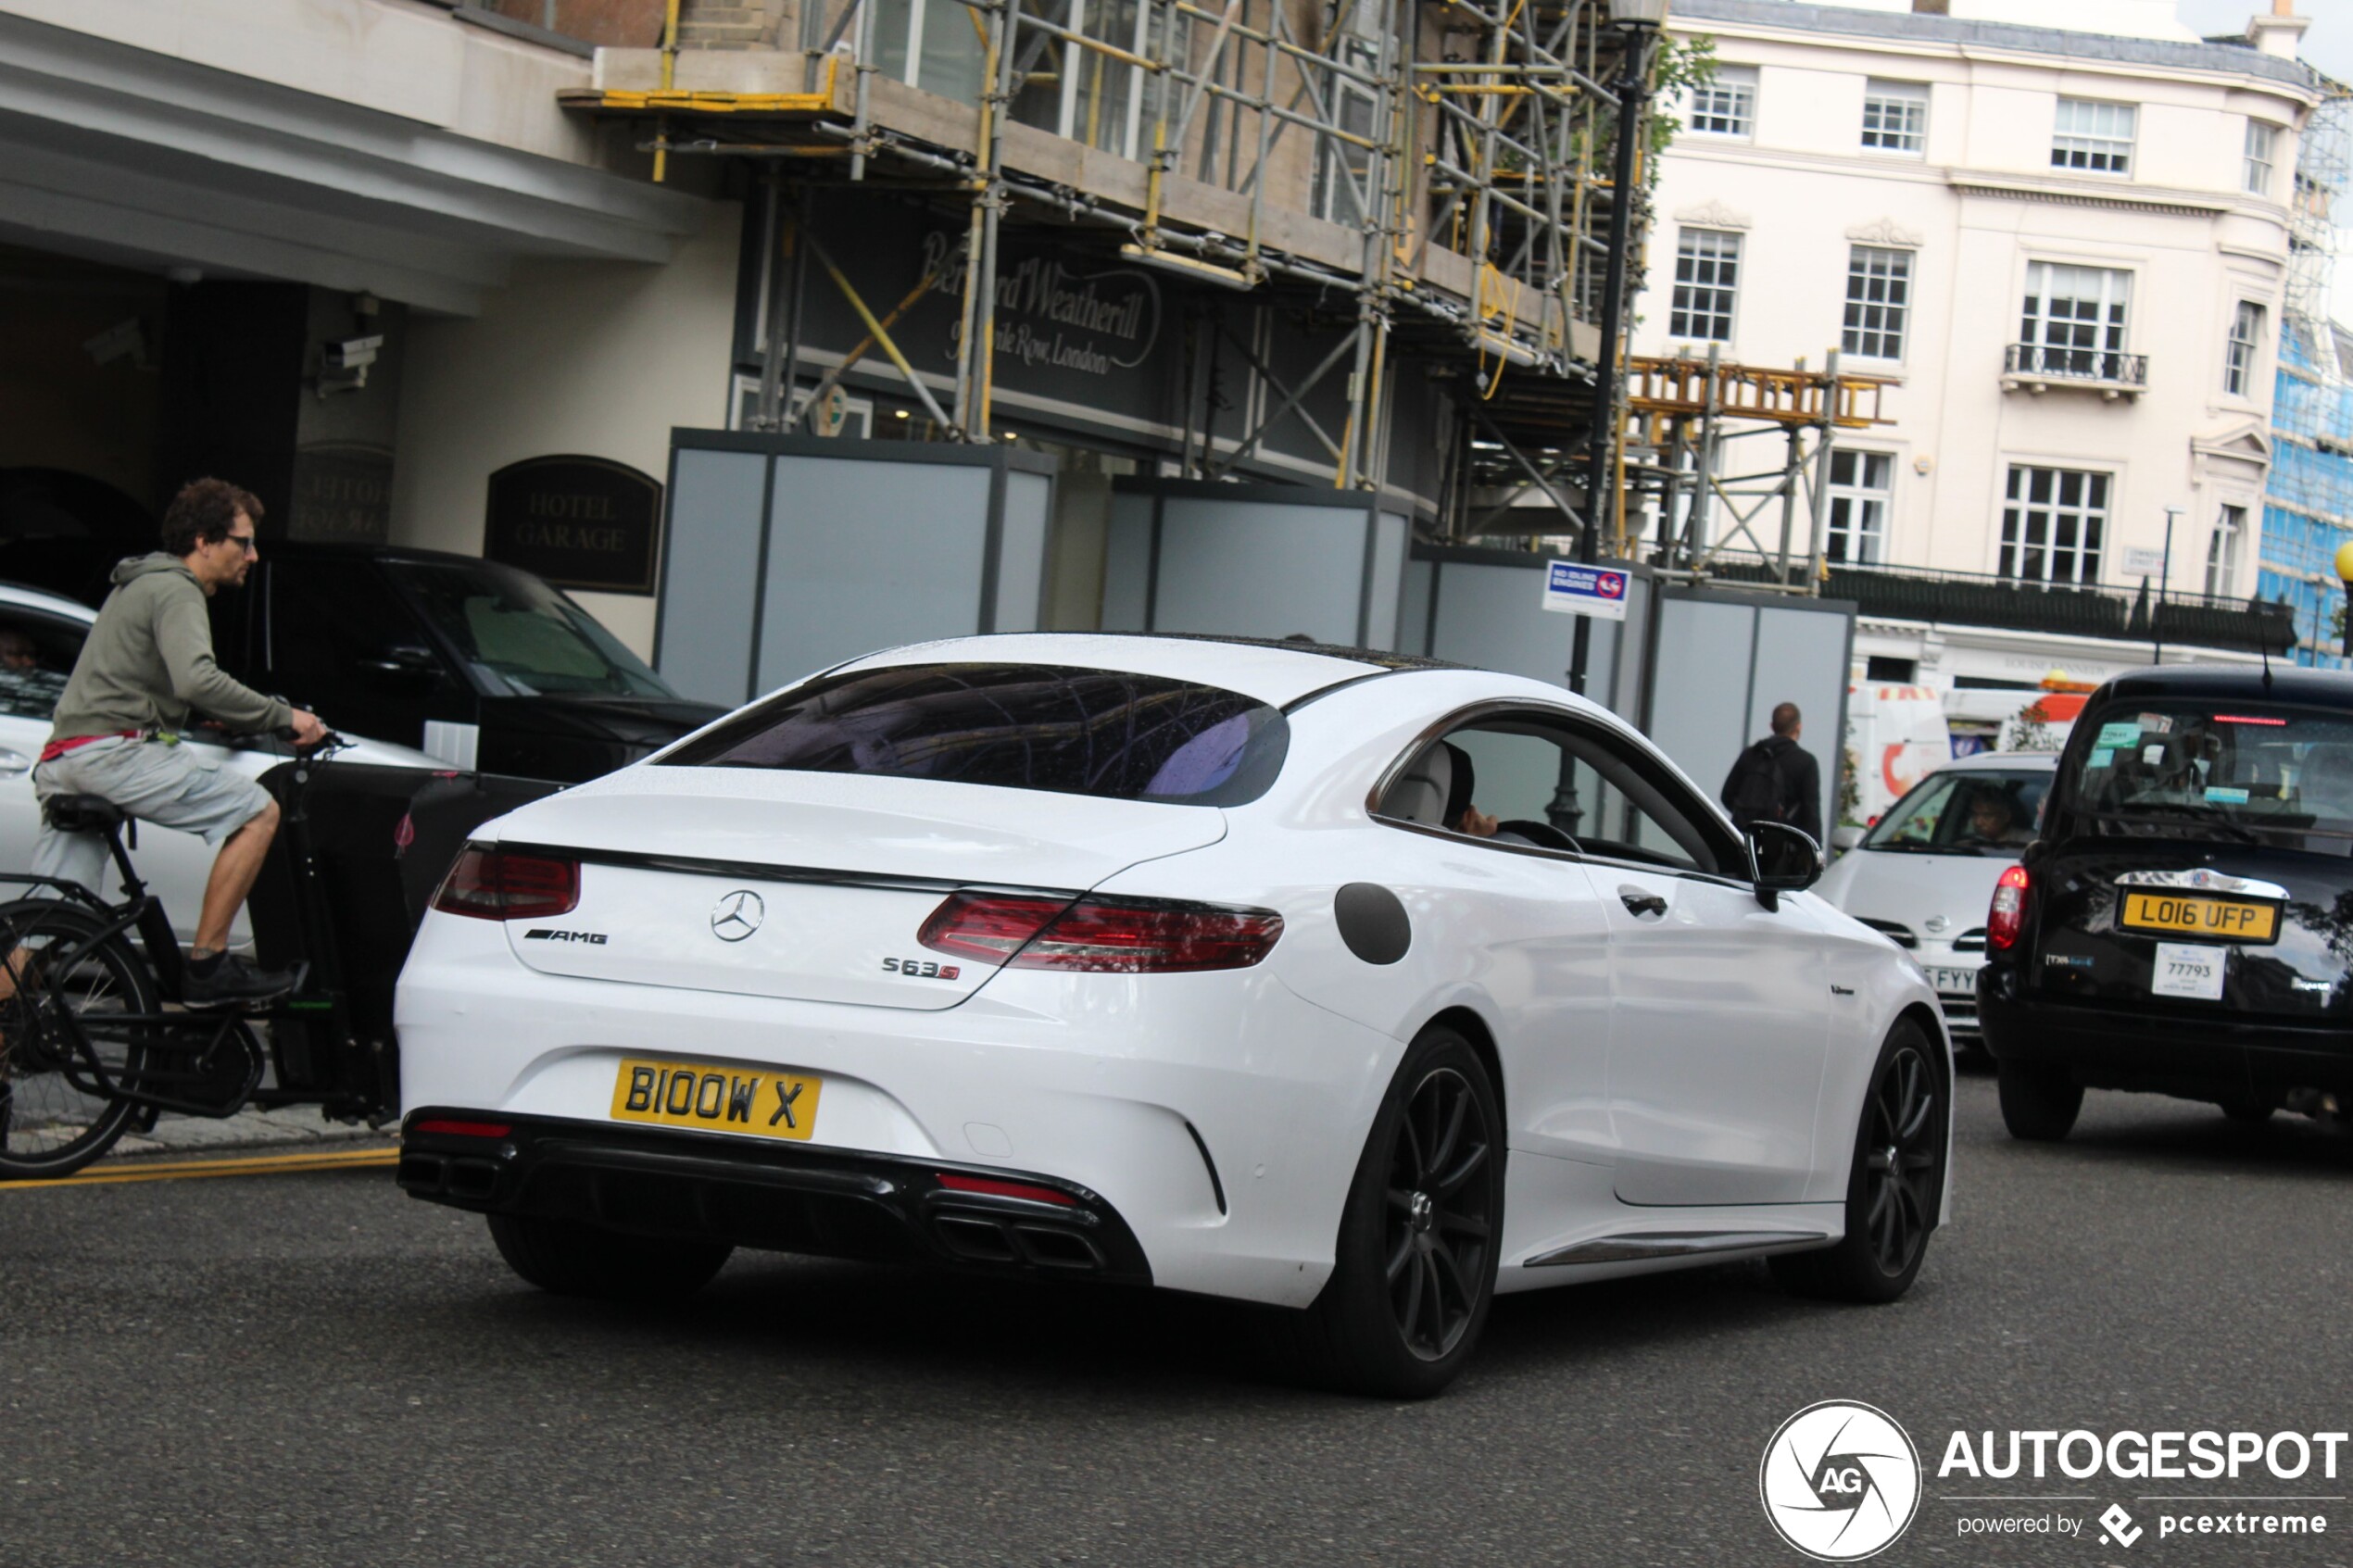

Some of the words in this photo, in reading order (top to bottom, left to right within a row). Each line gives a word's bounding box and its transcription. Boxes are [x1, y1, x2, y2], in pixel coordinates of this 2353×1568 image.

[921, 231, 1025, 309] Berrd
[1023, 257, 1145, 341] Weatherill
[1052, 332, 1112, 375] London
[529, 492, 616, 521] HOTEL
[516, 521, 626, 552] GARAGE
[1553, 577, 1594, 591] ENGINES
[1554, 570, 1567, 578] NO
[1567, 571, 1597, 583] IDLING
[2141, 899, 2197, 925] LO16
[2205, 904, 2256, 931] UFP
[550, 930, 608, 945] AMG
[2168, 962, 2210, 978] 77793
[769, 1081, 803, 1129] X
